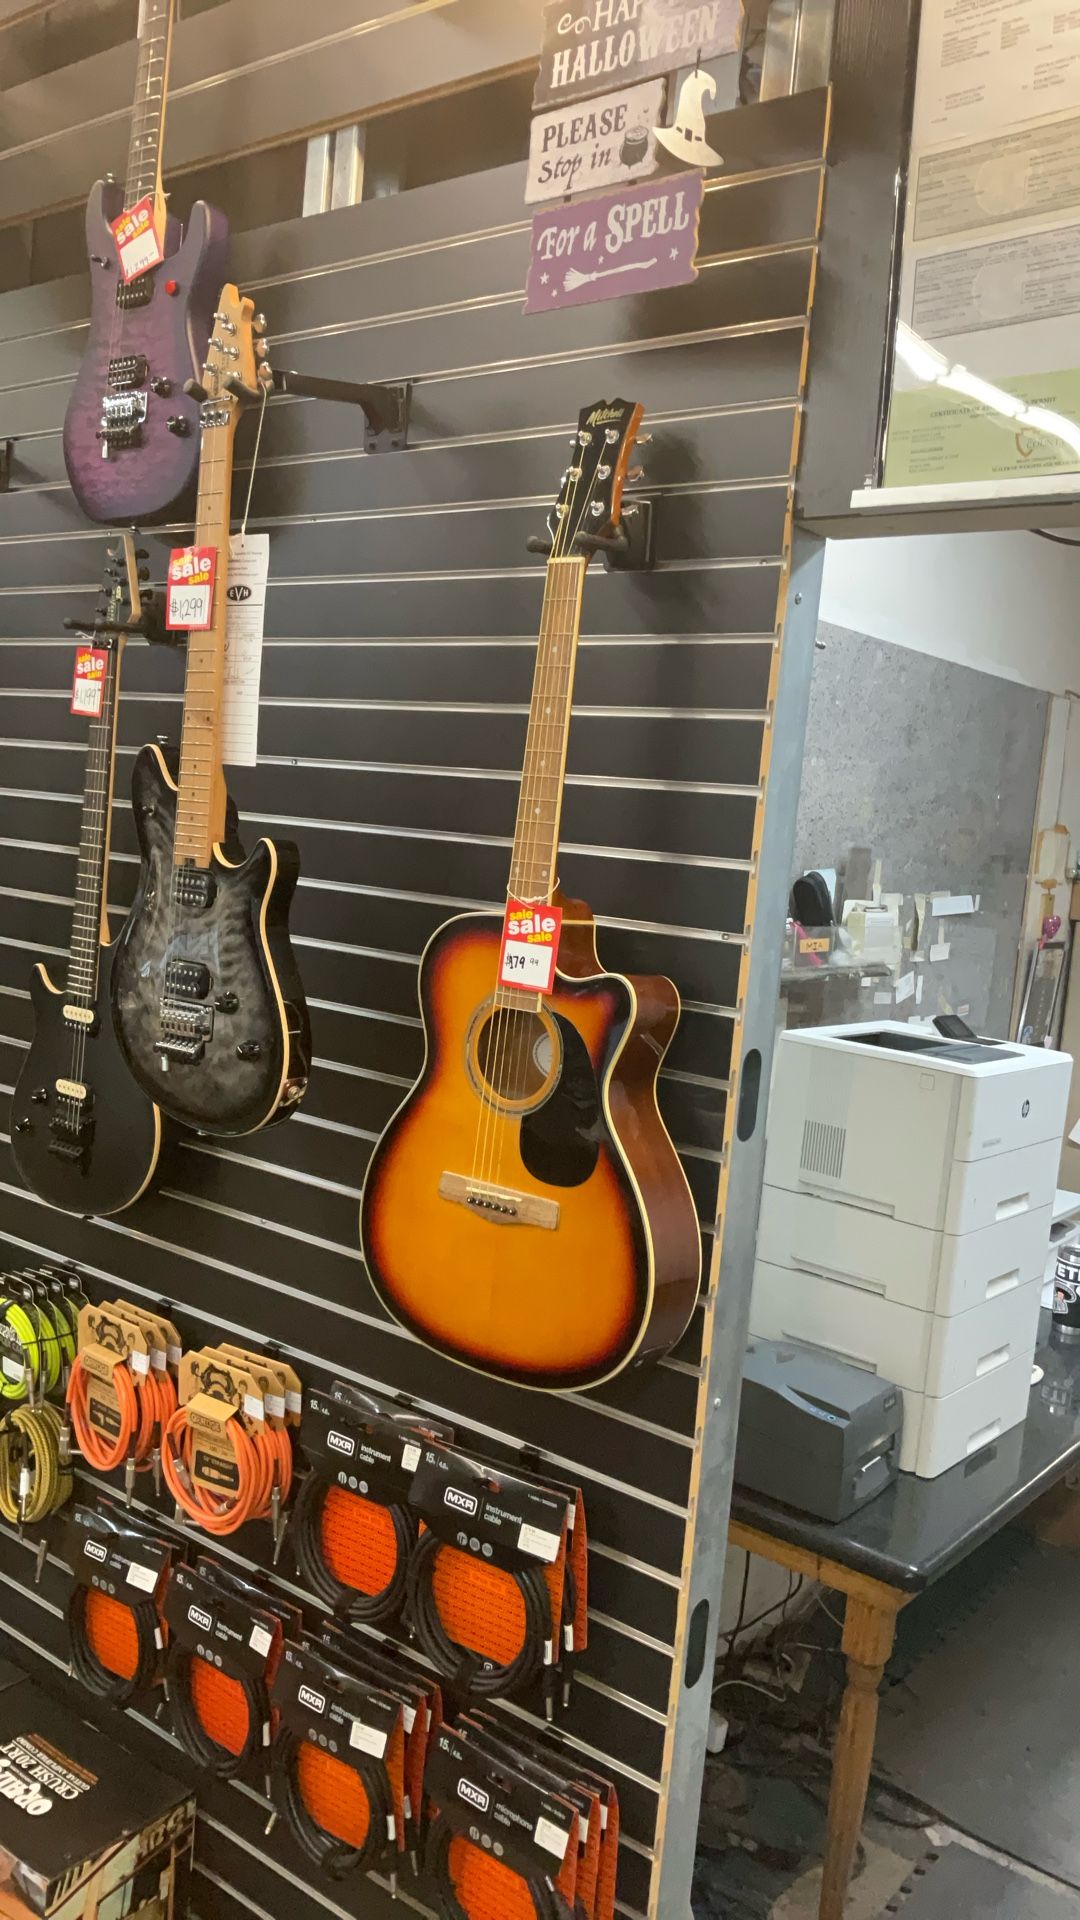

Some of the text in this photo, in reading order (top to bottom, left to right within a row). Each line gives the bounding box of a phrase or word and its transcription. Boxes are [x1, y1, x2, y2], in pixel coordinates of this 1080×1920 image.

[550, 2, 720, 88] HALLOWEEN
[541, 103, 629, 153] PLEASE
[537, 142, 612, 192] Stop in
[117, 209, 149, 245] sale
[537, 191, 690, 260] For a SPELL
[172, 556, 212, 580] sale
[229, 586, 249, 602] EVH
[170, 598, 203, 620] $1,299
[77, 656, 104, 674] sale
[508, 914, 556, 935] sale
[510, 909, 533, 921] sale
[527, 931, 552, 943] sale
[330, 1435, 352, 1452] MXR
[361, 1444, 391, 1462] instrument
[360, 1453, 375, 1464] cable
[447, 1491, 474, 1511] MXR
[484, 1513, 501, 1526] cable
[485, 1503, 522, 1524] instrument
[86, 1544, 105, 1558] MXR
[190, 1610, 209, 1627] MXR
[301, 1689, 323, 1708] MXR
[0, 1742, 37, 1769] 20RT
[28, 1766, 79, 1800] CRUSH
[461, 1783, 486, 1806] MXR
[495, 1802, 534, 1831] microphone
